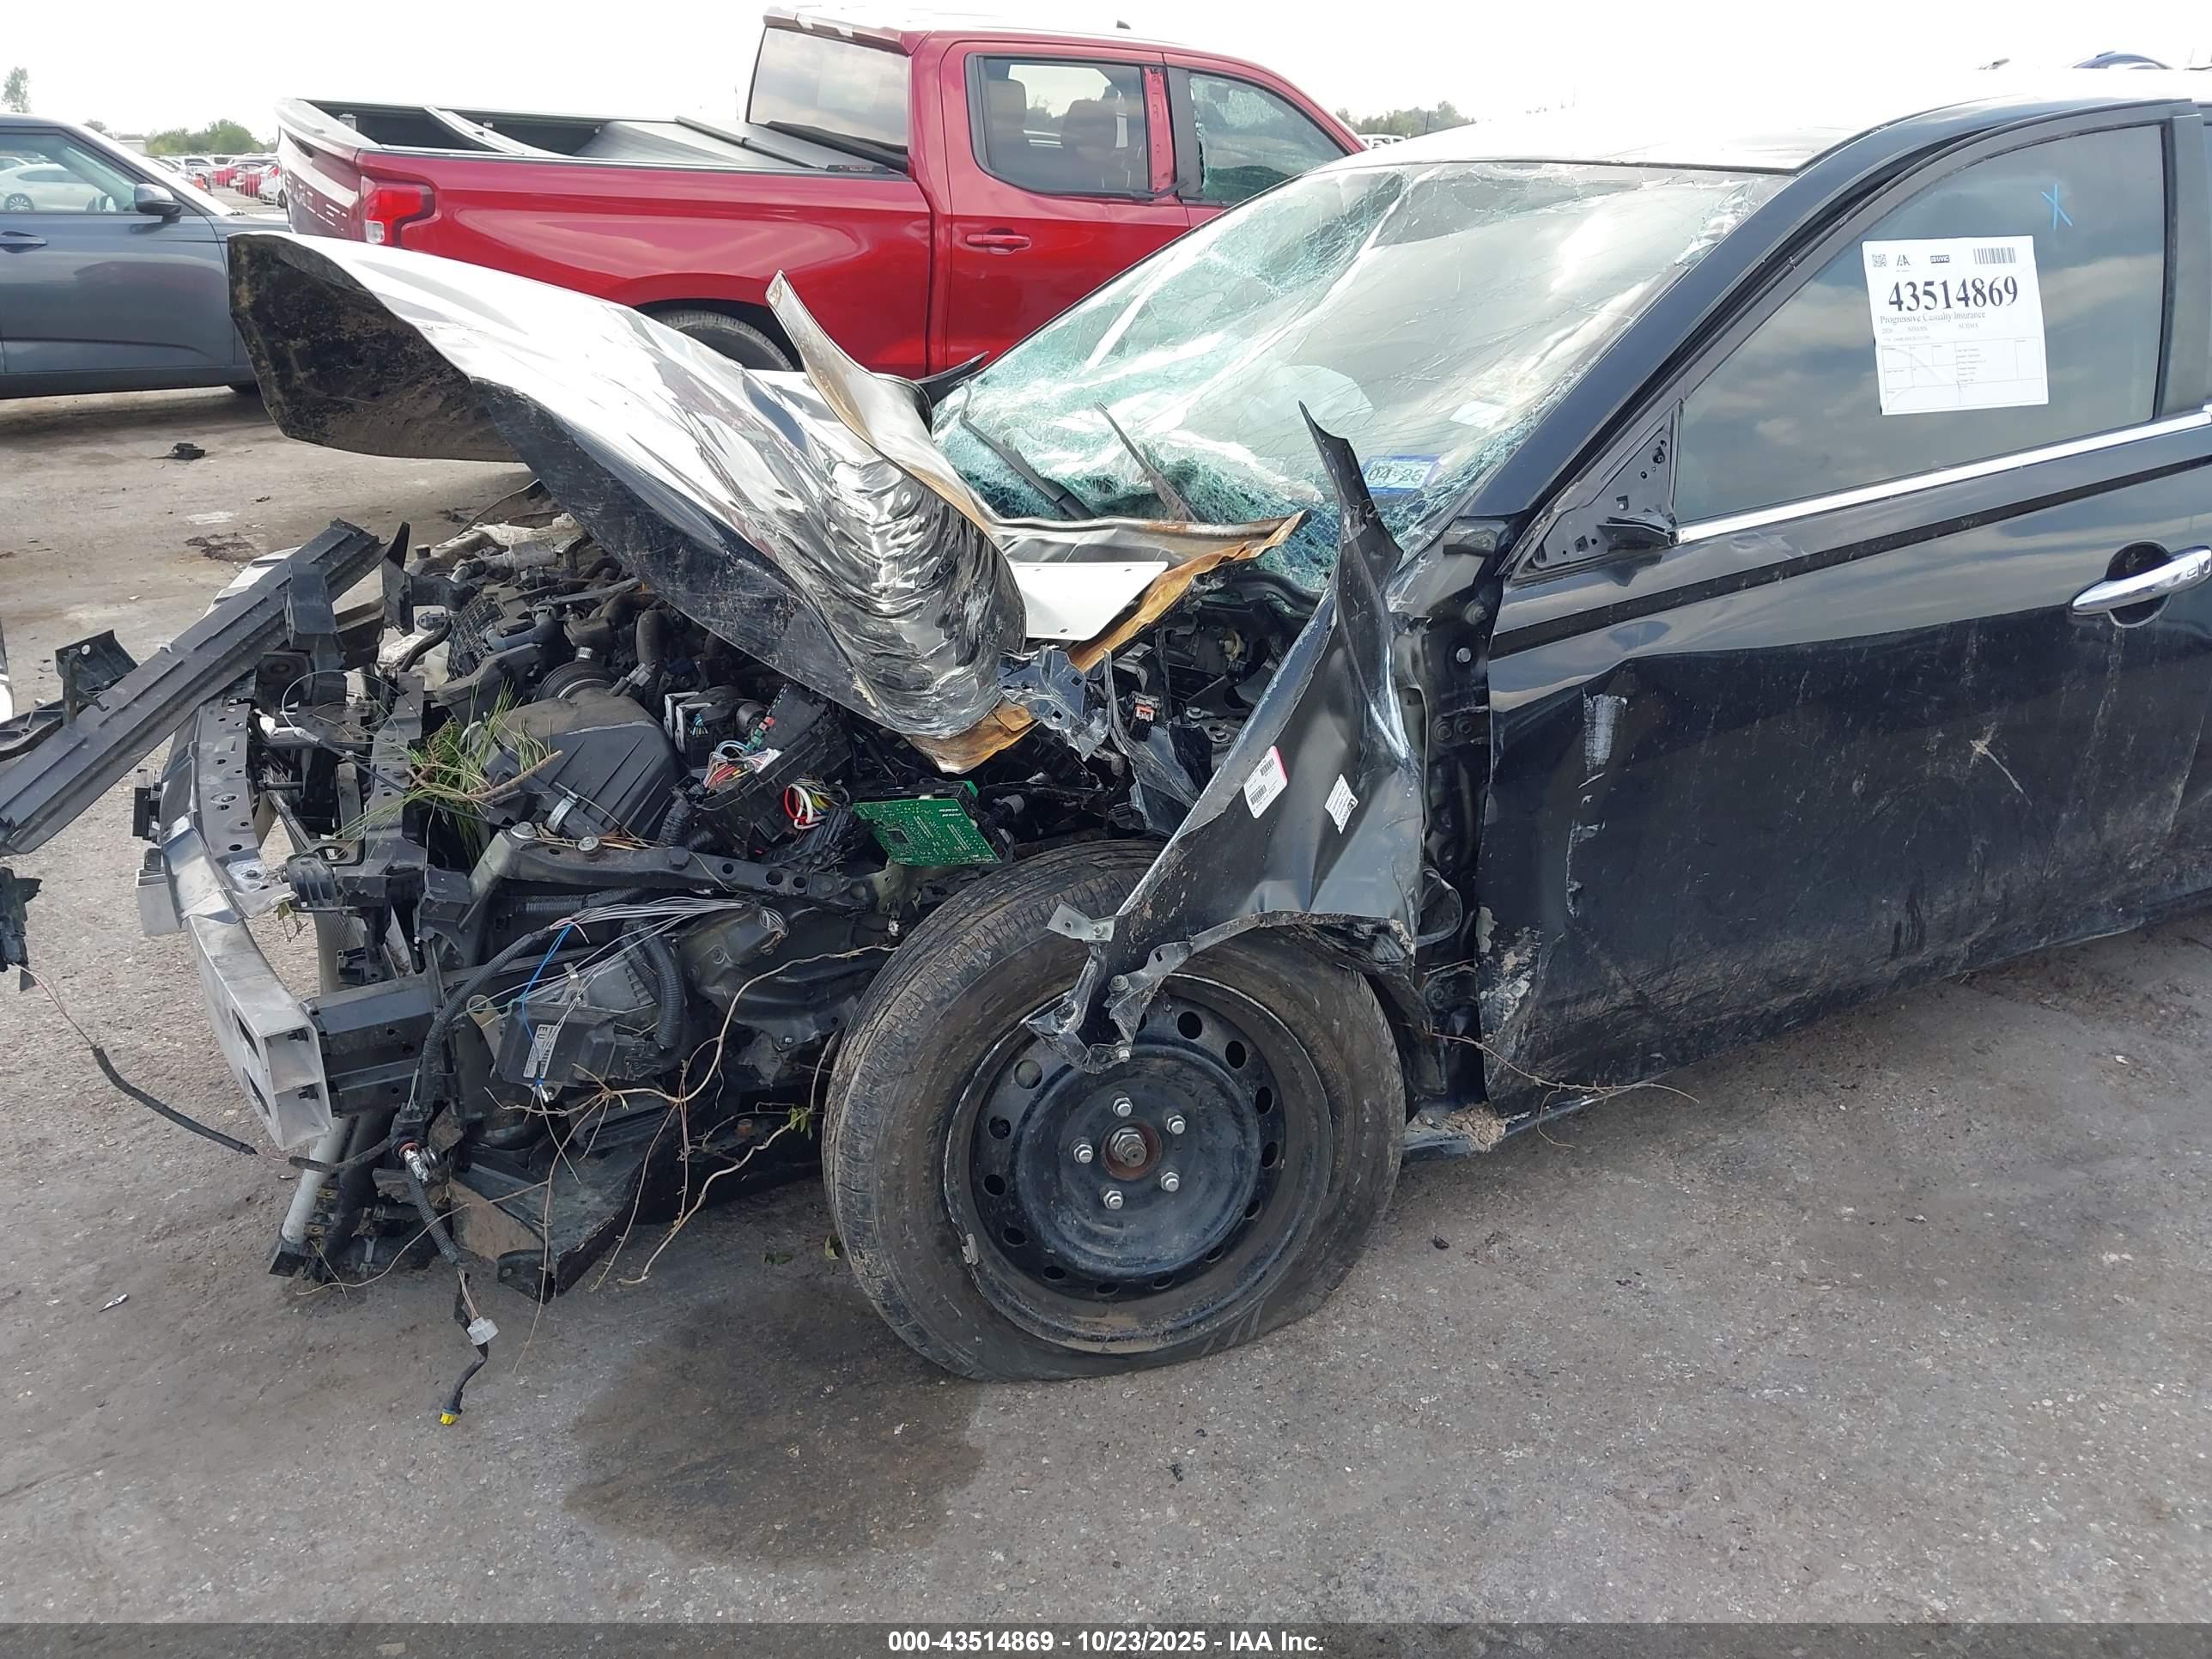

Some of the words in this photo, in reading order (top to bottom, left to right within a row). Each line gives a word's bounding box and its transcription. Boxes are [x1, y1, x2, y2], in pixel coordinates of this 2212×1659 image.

[1888, 276, 2018, 312] 43514869
[1880, 314, 1921, 325] Progressive
[1954, 311, 1986, 320] Insurance
